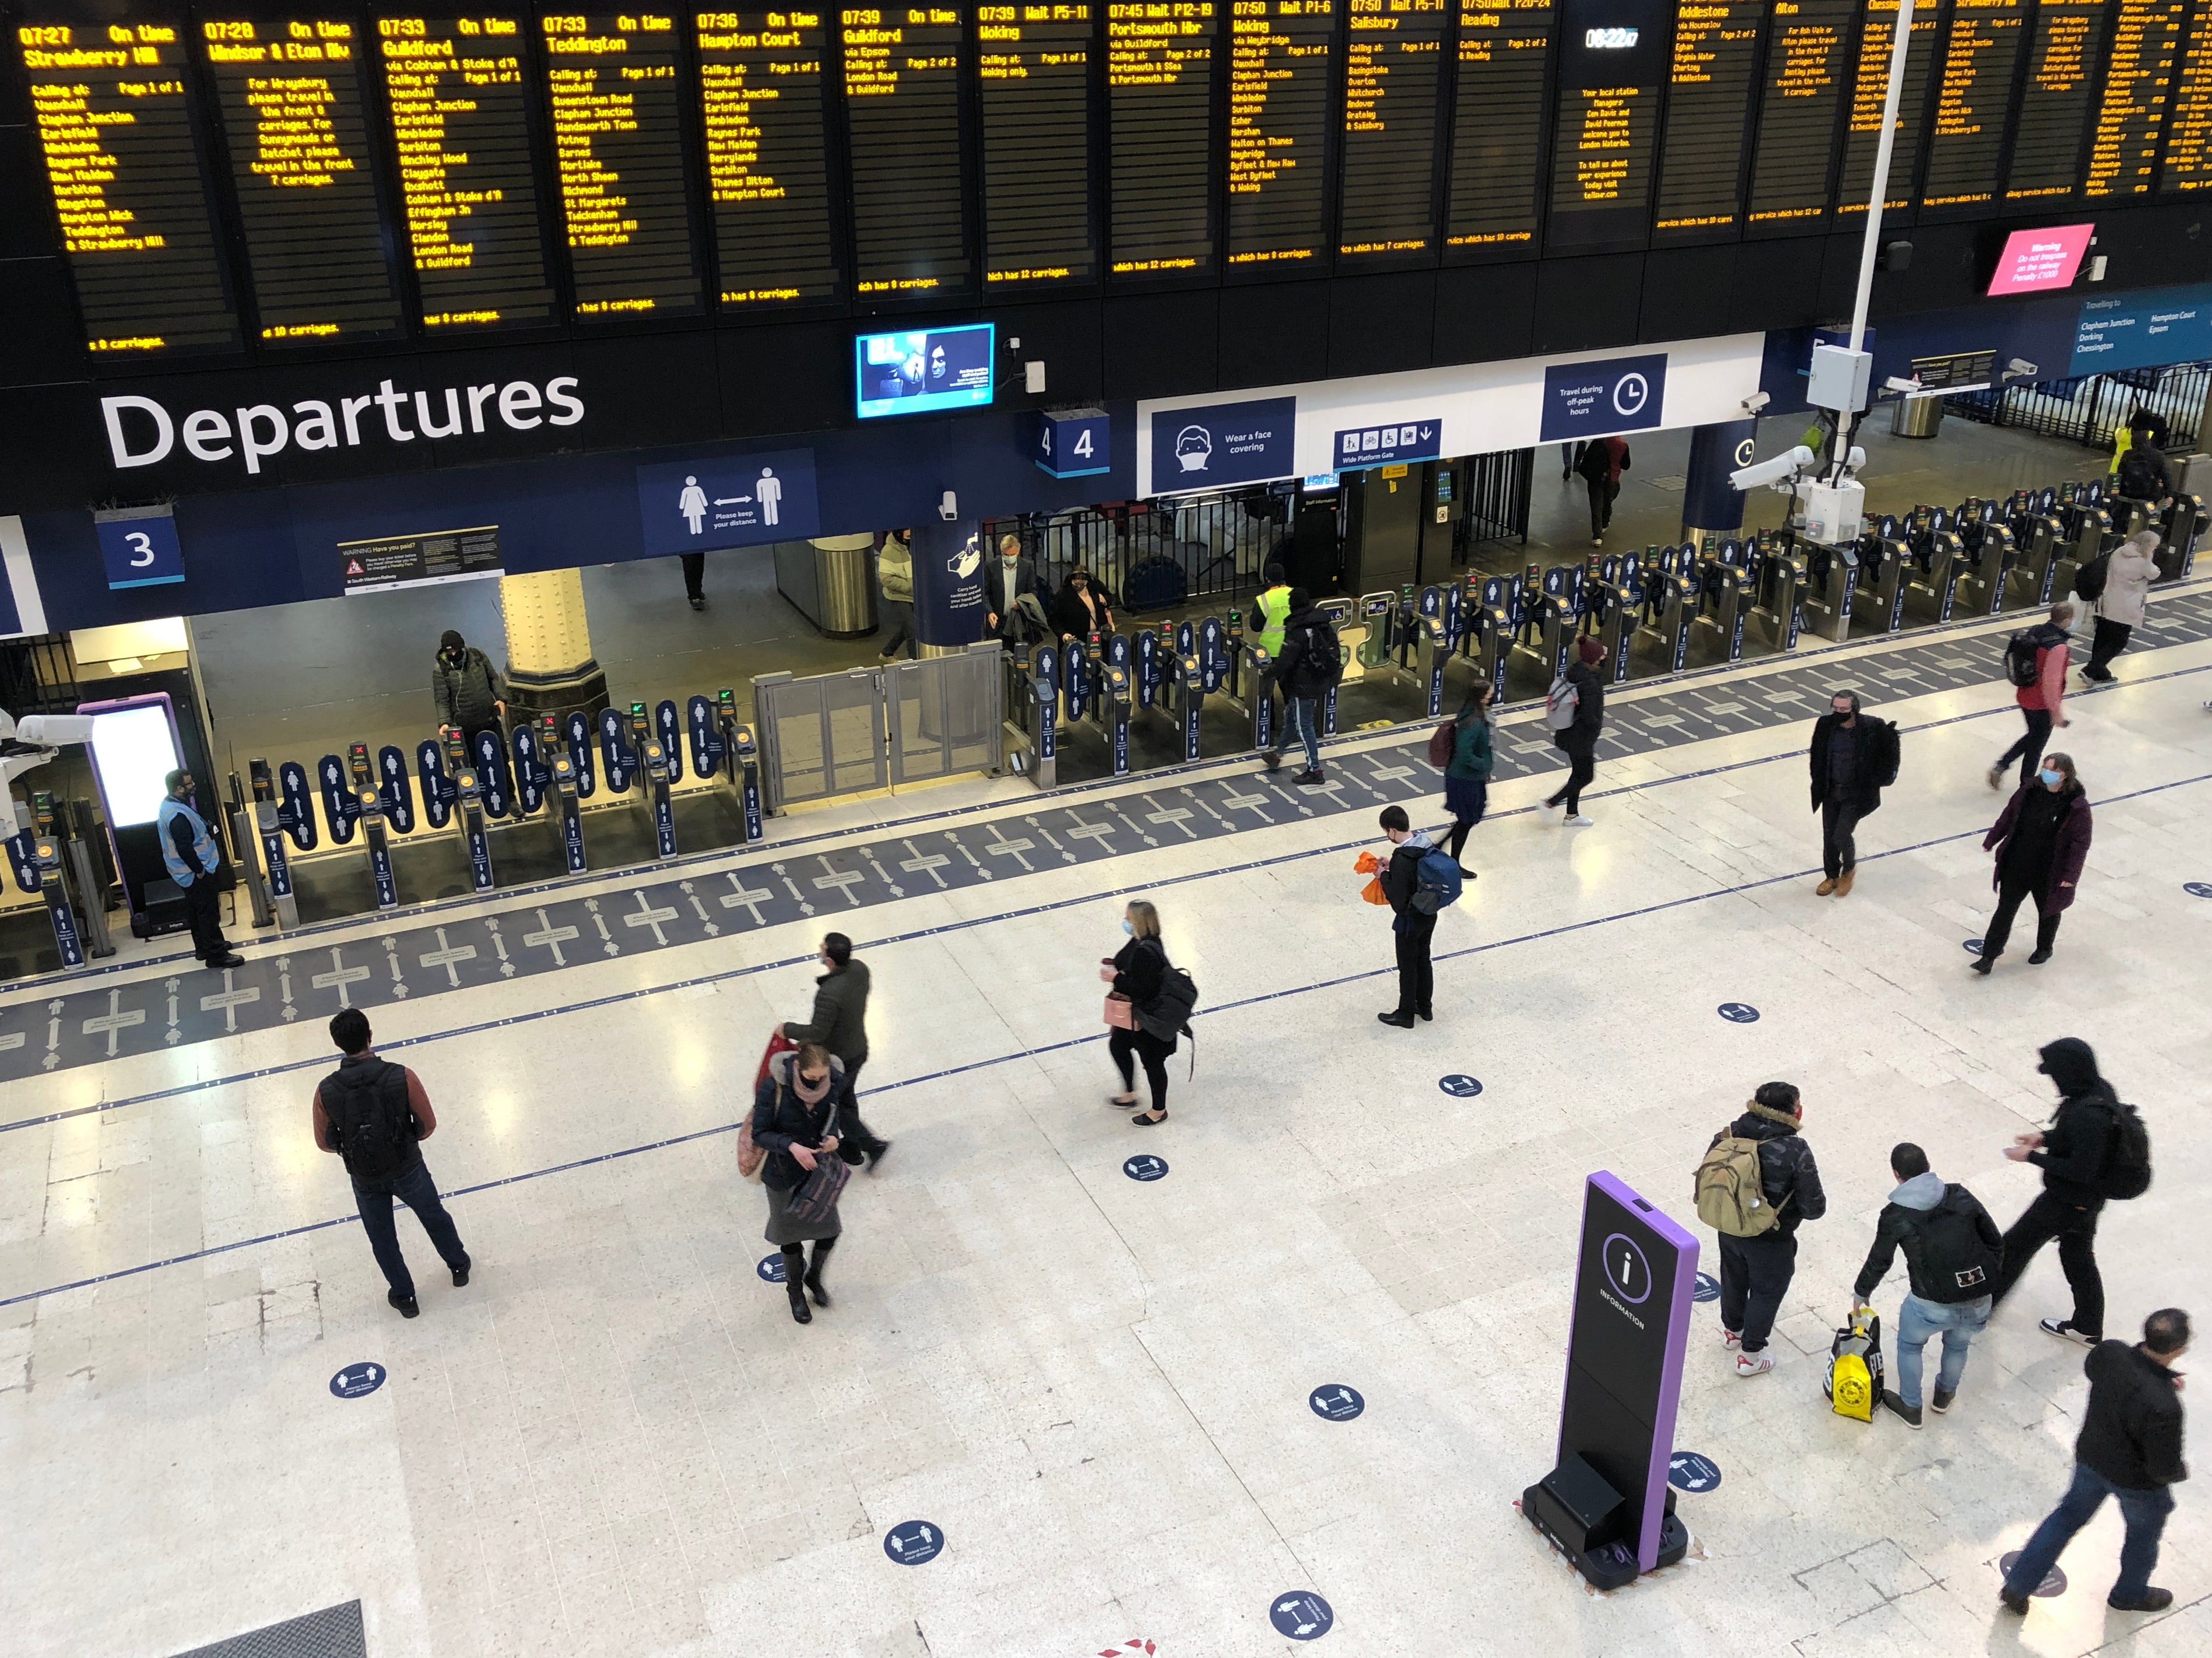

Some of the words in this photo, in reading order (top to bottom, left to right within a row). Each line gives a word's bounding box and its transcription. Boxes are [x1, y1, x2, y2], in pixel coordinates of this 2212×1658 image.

[979, 6, 1015, 21] 07:39
[1025, 5, 1049, 20] Wait
[1054, 5, 1087, 19] P5-11
[1109, 4, 1143, 18] 07:45
[1146, 3, 1170, 18] Wait
[1174, 3, 1212, 16] P12-19
[1233, 1, 1266, 16] 07:50
[1279, 1, 1302, 15] Wait
[1305, 0, 1331, 13] P1-6
[1679, 5, 1729, 19] Addlestone
[1775, 2, 1799, 14] Alton
[697, 13, 738, 29] 07:36
[767, 12, 786, 27] On
[790, 12, 818, 27] time
[842, 10, 880, 24] 07:39
[908, 9, 925, 23] On
[930, 9, 956, 23] time
[1350, 16, 1399, 30] Salisbury
[1461, 13, 1500, 27] Reading
[204, 22, 254, 40] 07:28
[289, 22, 313, 39] On
[317, 21, 352, 38] time
[379, 19, 426, 37] 07:33
[459, 18, 480, 35] On
[484, 17, 516, 34] time
[543, 16, 587, 33] 07:33
[617, 15, 637, 30] On
[641, 15, 671, 30] time
[1109, 22, 1178, 36] Portsmouth
[1181, 21, 1202, 34] Hbr
[1233, 19, 1269, 34] Woking
[19, 26, 71, 47] 07:27
[108, 25, 135, 43] On
[138, 24, 175, 43] time
[843, 29, 901, 44] Guildford
[979, 25, 1020, 40] Woking
[546, 36, 627, 54] Teddington
[699, 33, 757, 50] Hampton
[761, 31, 801, 47] Court
[1110, 40, 1122, 49] via
[1124, 38, 1168, 48] Guildford
[1233, 36, 1245, 45] via
[1246, 35, 1290, 47] Weybridge
[1459, 40, 1481, 50] Calling
[1508, 39, 1524, 49] Page
[1532, 38, 1540, 47] of
[1542, 38, 1547, 47] 2
[208, 44, 266, 62] Windsor
[270, 43, 283, 60] &
[286, 43, 324, 60] Eton
[325, 42, 350, 59] Riv
[382, 40, 453, 58] Guildford
[845, 47, 859, 57] via
[860, 47, 890, 58] Epsom
[24, 48, 128, 68] Strawberry
[132, 47, 159, 65] Hill
[1233, 58, 1265, 69] Vauxhall
[1349, 55, 1371, 65] Woking
[981, 67, 1007, 78] Woking
[1009, 66, 1028, 78] only.
[1109, 62, 1154, 72] Portsmouth
[1156, 62, 1162, 71] &
[1164, 61, 1182, 71] SSea
[1349, 65, 1389, 76] Basingstoke
[846, 72, 875, 82] London
[877, 71, 897, 81] Road
[389, 87, 434, 100] Vauxhall
[847, 85, 854, 94] &
[856, 83, 894, 94] Guildford
[1347, 87, 1385, 97] Whitchurch
[1232, 104, 1262, 114] Surbiton
[37, 113, 85, 127] Clapham
[86, 111, 135, 124] Junction
[1346, 122, 1352, 130] &
[1353, 121, 1384, 130] Salisbury
[707, 128, 738, 140] Raynes
[740, 127, 761, 136] Park
[557, 135, 590, 146] Putney
[560, 159, 602, 171] Mortlake
[402, 167, 445, 180] Claygate
[404, 180, 445, 192] Oxshott
[711, 178, 744, 188] Thames
[746, 176, 773, 186] Ditton
[563, 184, 603, 196] Richmond
[564, 198, 577, 208] St
[578, 196, 626, 209] Margarets
[62, 225, 125, 238] Teddington
[413, 245, 448, 257] London
[450, 243, 473, 254] Road
[2032, 243, 2062, 252] Warning
[2018, 255, 2028, 263] Do
[2041, 252, 2067, 261] trespass
[2038, 262, 2062, 270] railway
[2012, 272, 2037, 282] Penalty
[2037, 270, 2058, 279] £1000
[2087, 300, 2113, 309] Travelling
[2151, 313, 2179, 323] Hampton
[2179, 311, 2196, 320] Court
[2081, 321, 2109, 331] Clapham
[2109, 318, 2135, 327] Junction
[2149, 325, 2169, 335] Epsom
[2079, 332, 2104, 342] Dorking
[2077, 343, 2114, 353] Chessington
[1560, 387, 1580, 396] Travel
[1581, 385, 1603, 394] during
[1567, 395, 1595, 406] off-peak
[1570, 408, 1589, 416] hours
[100, 376, 585, 474] Departures
[1042, 427, 1051, 456] 4
[1225, 434, 1247, 443] Wear
[1255, 430, 1272, 439] face
[1074, 429, 1094, 458] 4
[1230, 443, 1264, 454] covering
[1357, 454, 1381, 462] Platform
[125, 532, 155, 568] 3
[342, 548, 372, 556] WARNING
[400, 542, 416, 551] paid?
[1622, 1252, 1631, 1285] i
[1600, 1288, 1645, 1330] INFORMATION
